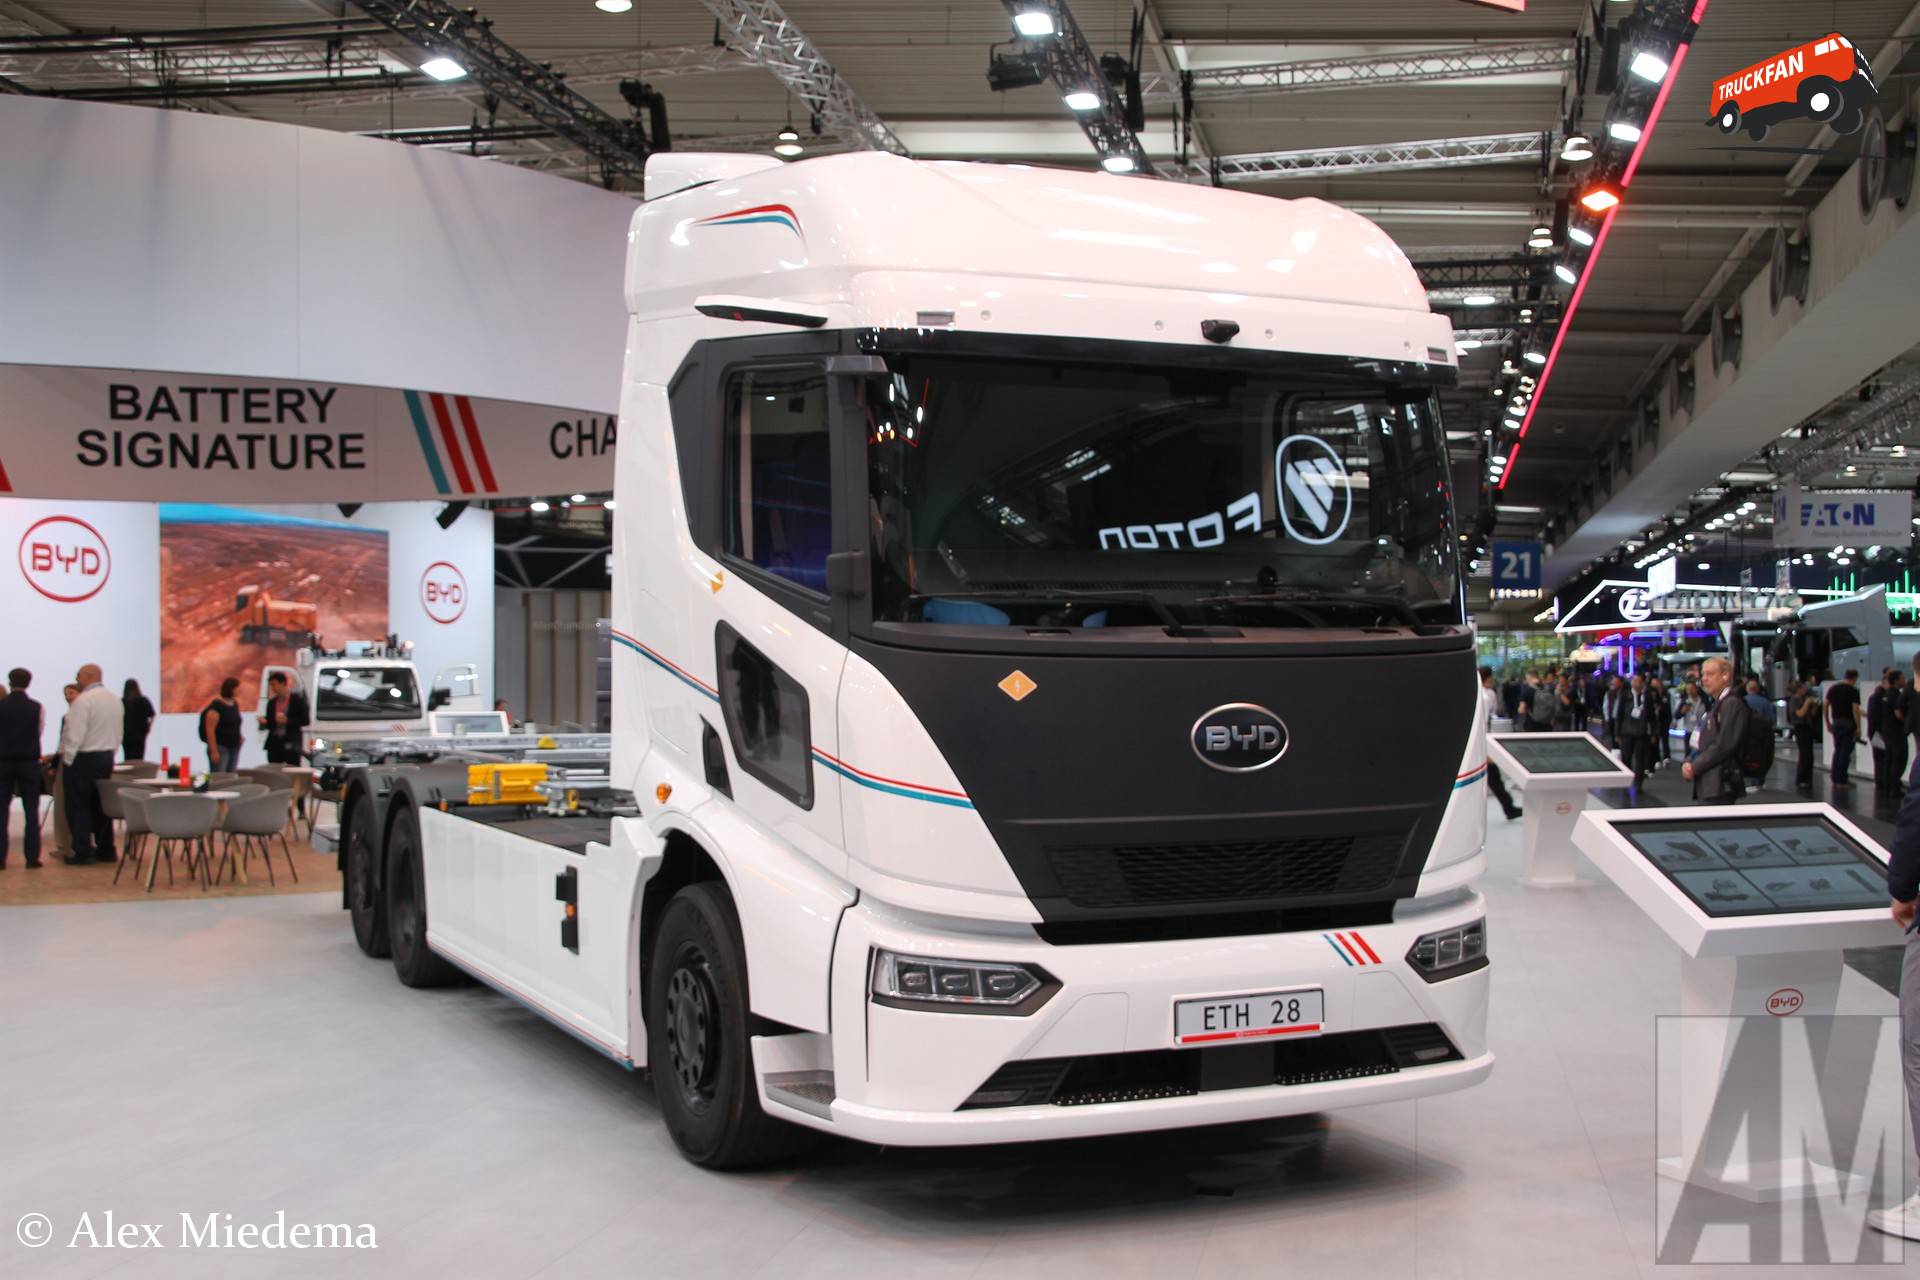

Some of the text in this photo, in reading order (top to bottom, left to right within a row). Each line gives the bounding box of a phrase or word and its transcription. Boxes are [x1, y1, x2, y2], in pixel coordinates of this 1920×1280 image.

[108, 384, 337, 424] BATTERY
[76, 429, 366, 470] SIGNATURE
[32, 543, 100, 575] BYD
[1501, 551, 1531, 579] 21
[427, 581, 462, 603] BYD
[1205, 725, 1280, 751] BYD
[1204, 998, 1301, 1030] ETH 28
[1770, 997, 1800, 1009] BYD
